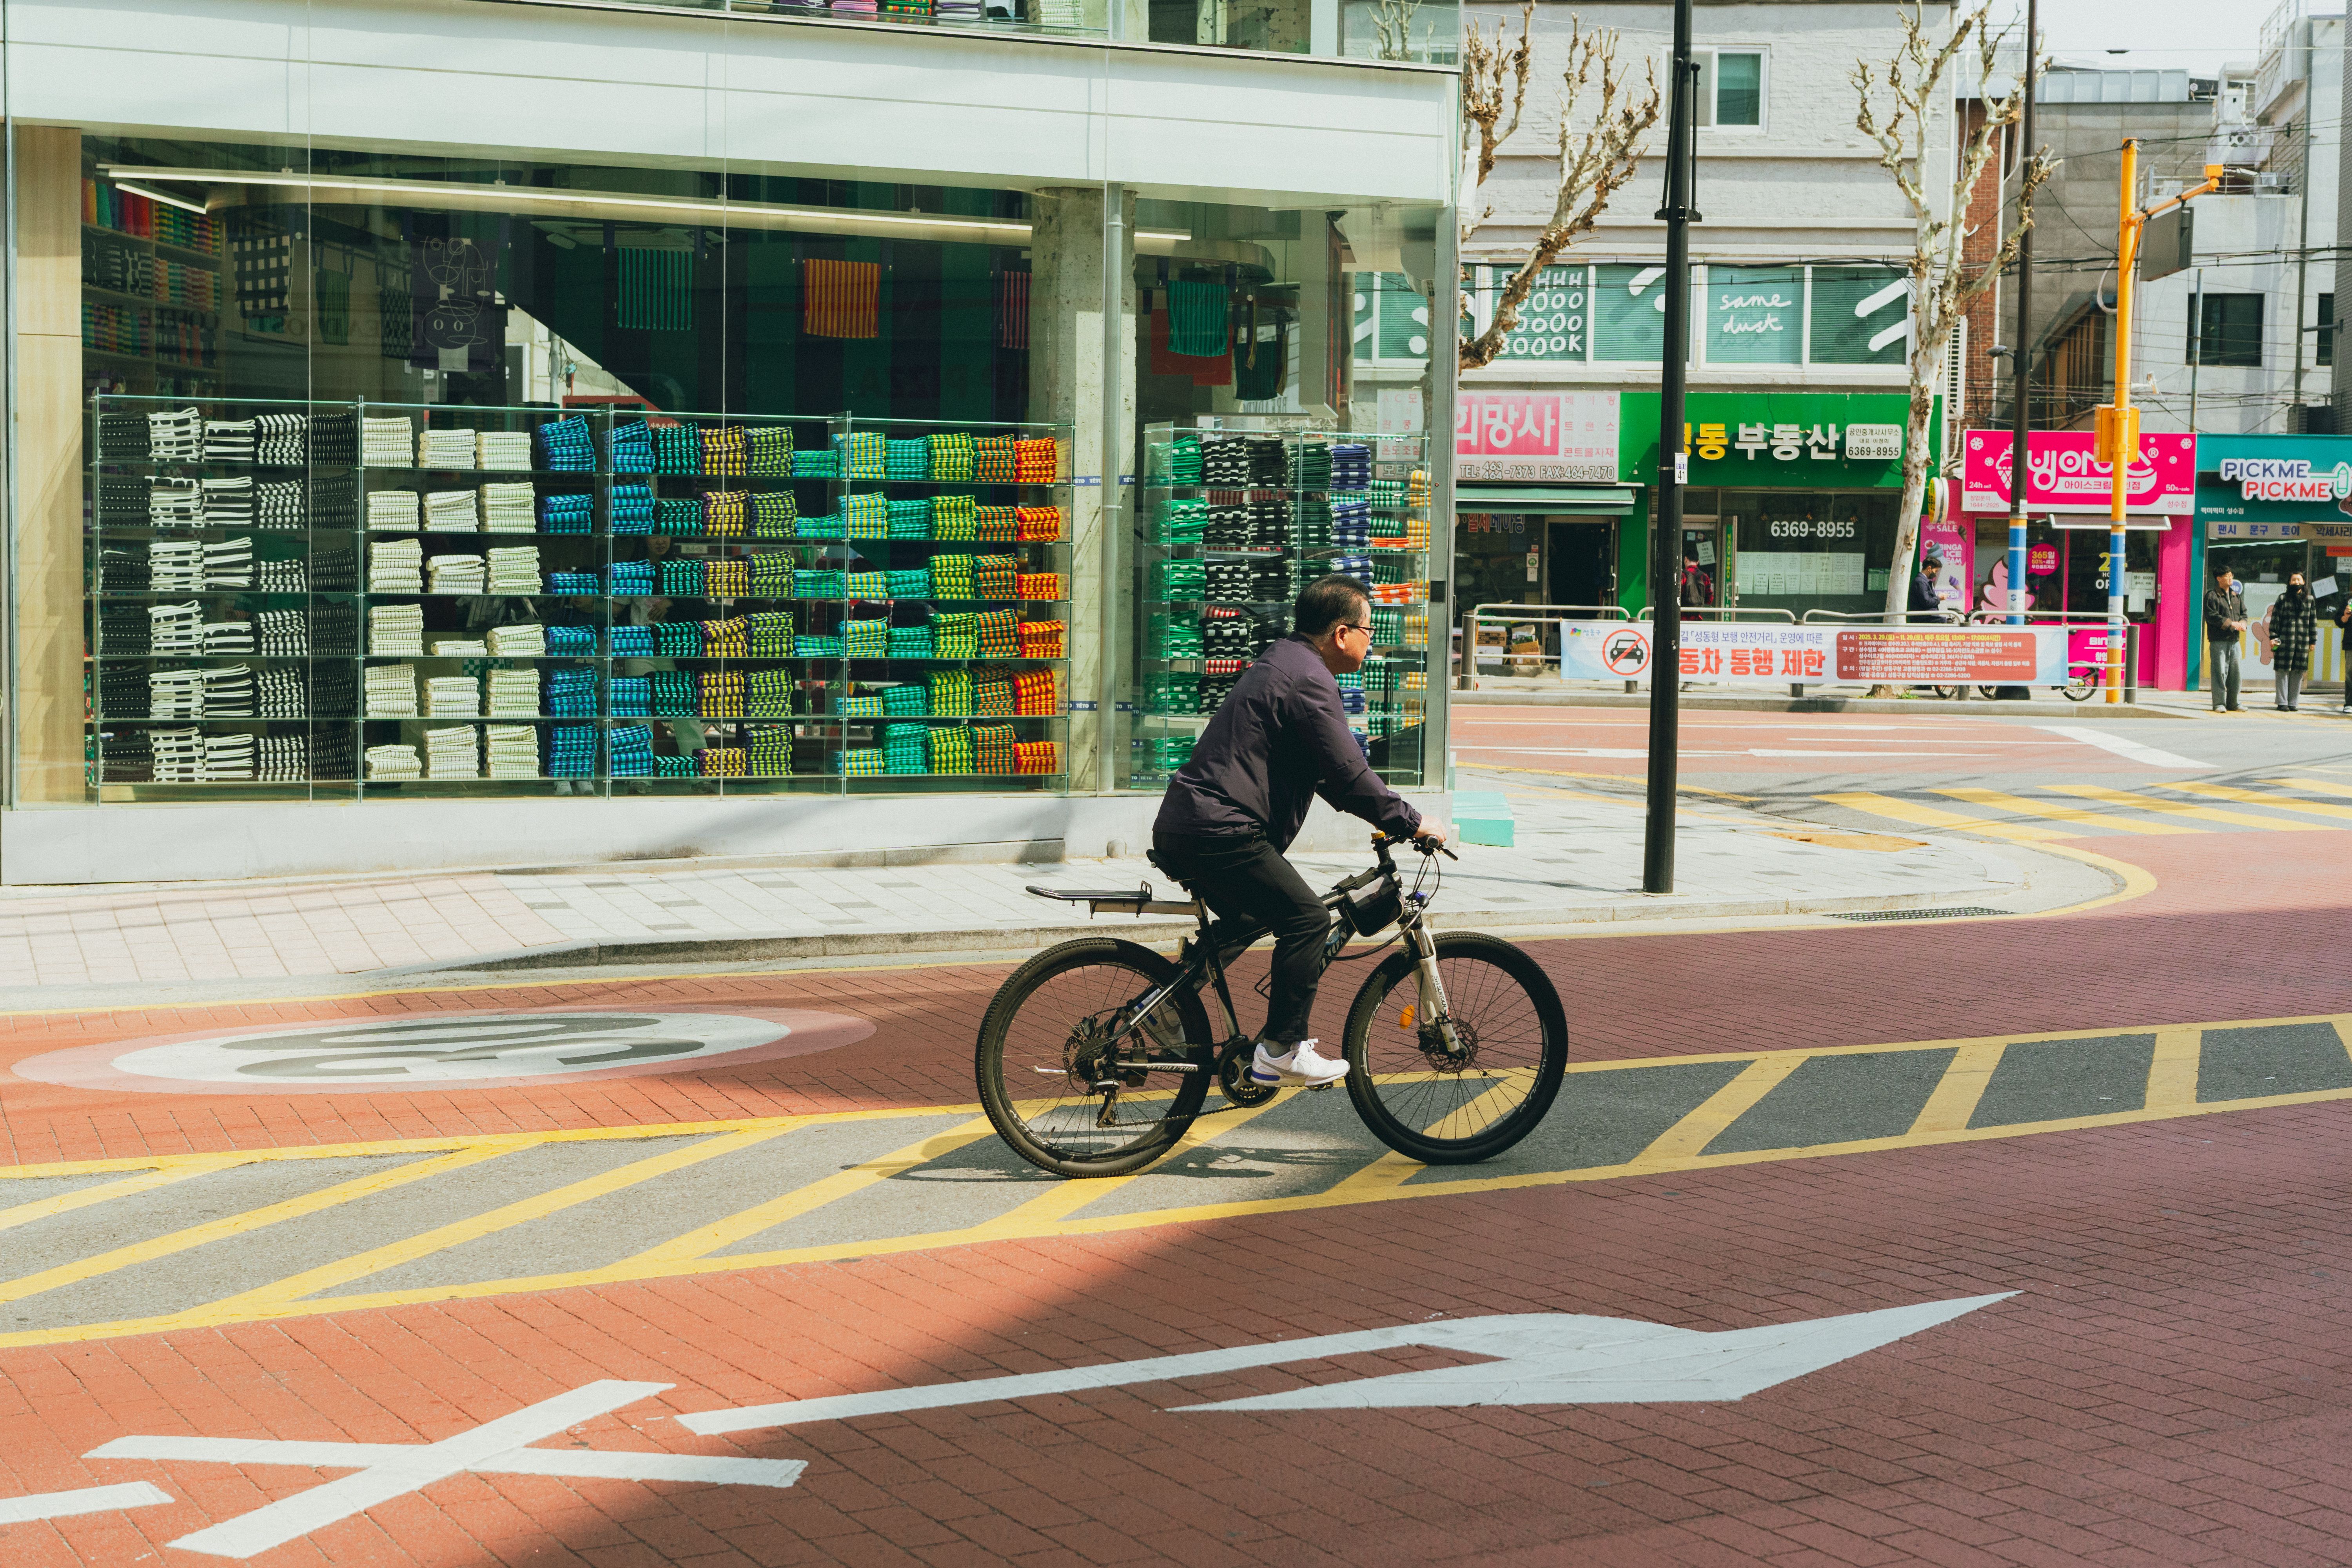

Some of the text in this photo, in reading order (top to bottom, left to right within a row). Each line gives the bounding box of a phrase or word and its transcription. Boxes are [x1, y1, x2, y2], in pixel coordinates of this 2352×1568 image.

[1720, 294, 1792, 310] same
[1723, 313, 1783, 334] dust
[1735, 423, 1840, 461] 부동산
[1849, 446, 1899, 456] 6369-8955
[1460, 465, 1479, 478] TEL:
[1482, 461, 1503, 470] 463
[1482, 470, 1503, 480] 464
[1678, 470, 1684, 480] 41
[2224, 462, 2308, 478] PICKME
[2246, 481, 2329, 498] PICKME
[1771, 521, 1855, 538] 6369-8955
[2218, 524, 2352, 537] 팬시 문구 토이 악세사리
[1722, 632, 1738, 643] 보행
[1780, 633, 1804, 644] 운영에
[1806, 633, 1823, 644] 따른
[1679, 648, 1826, 676] 동차 통행 제한
